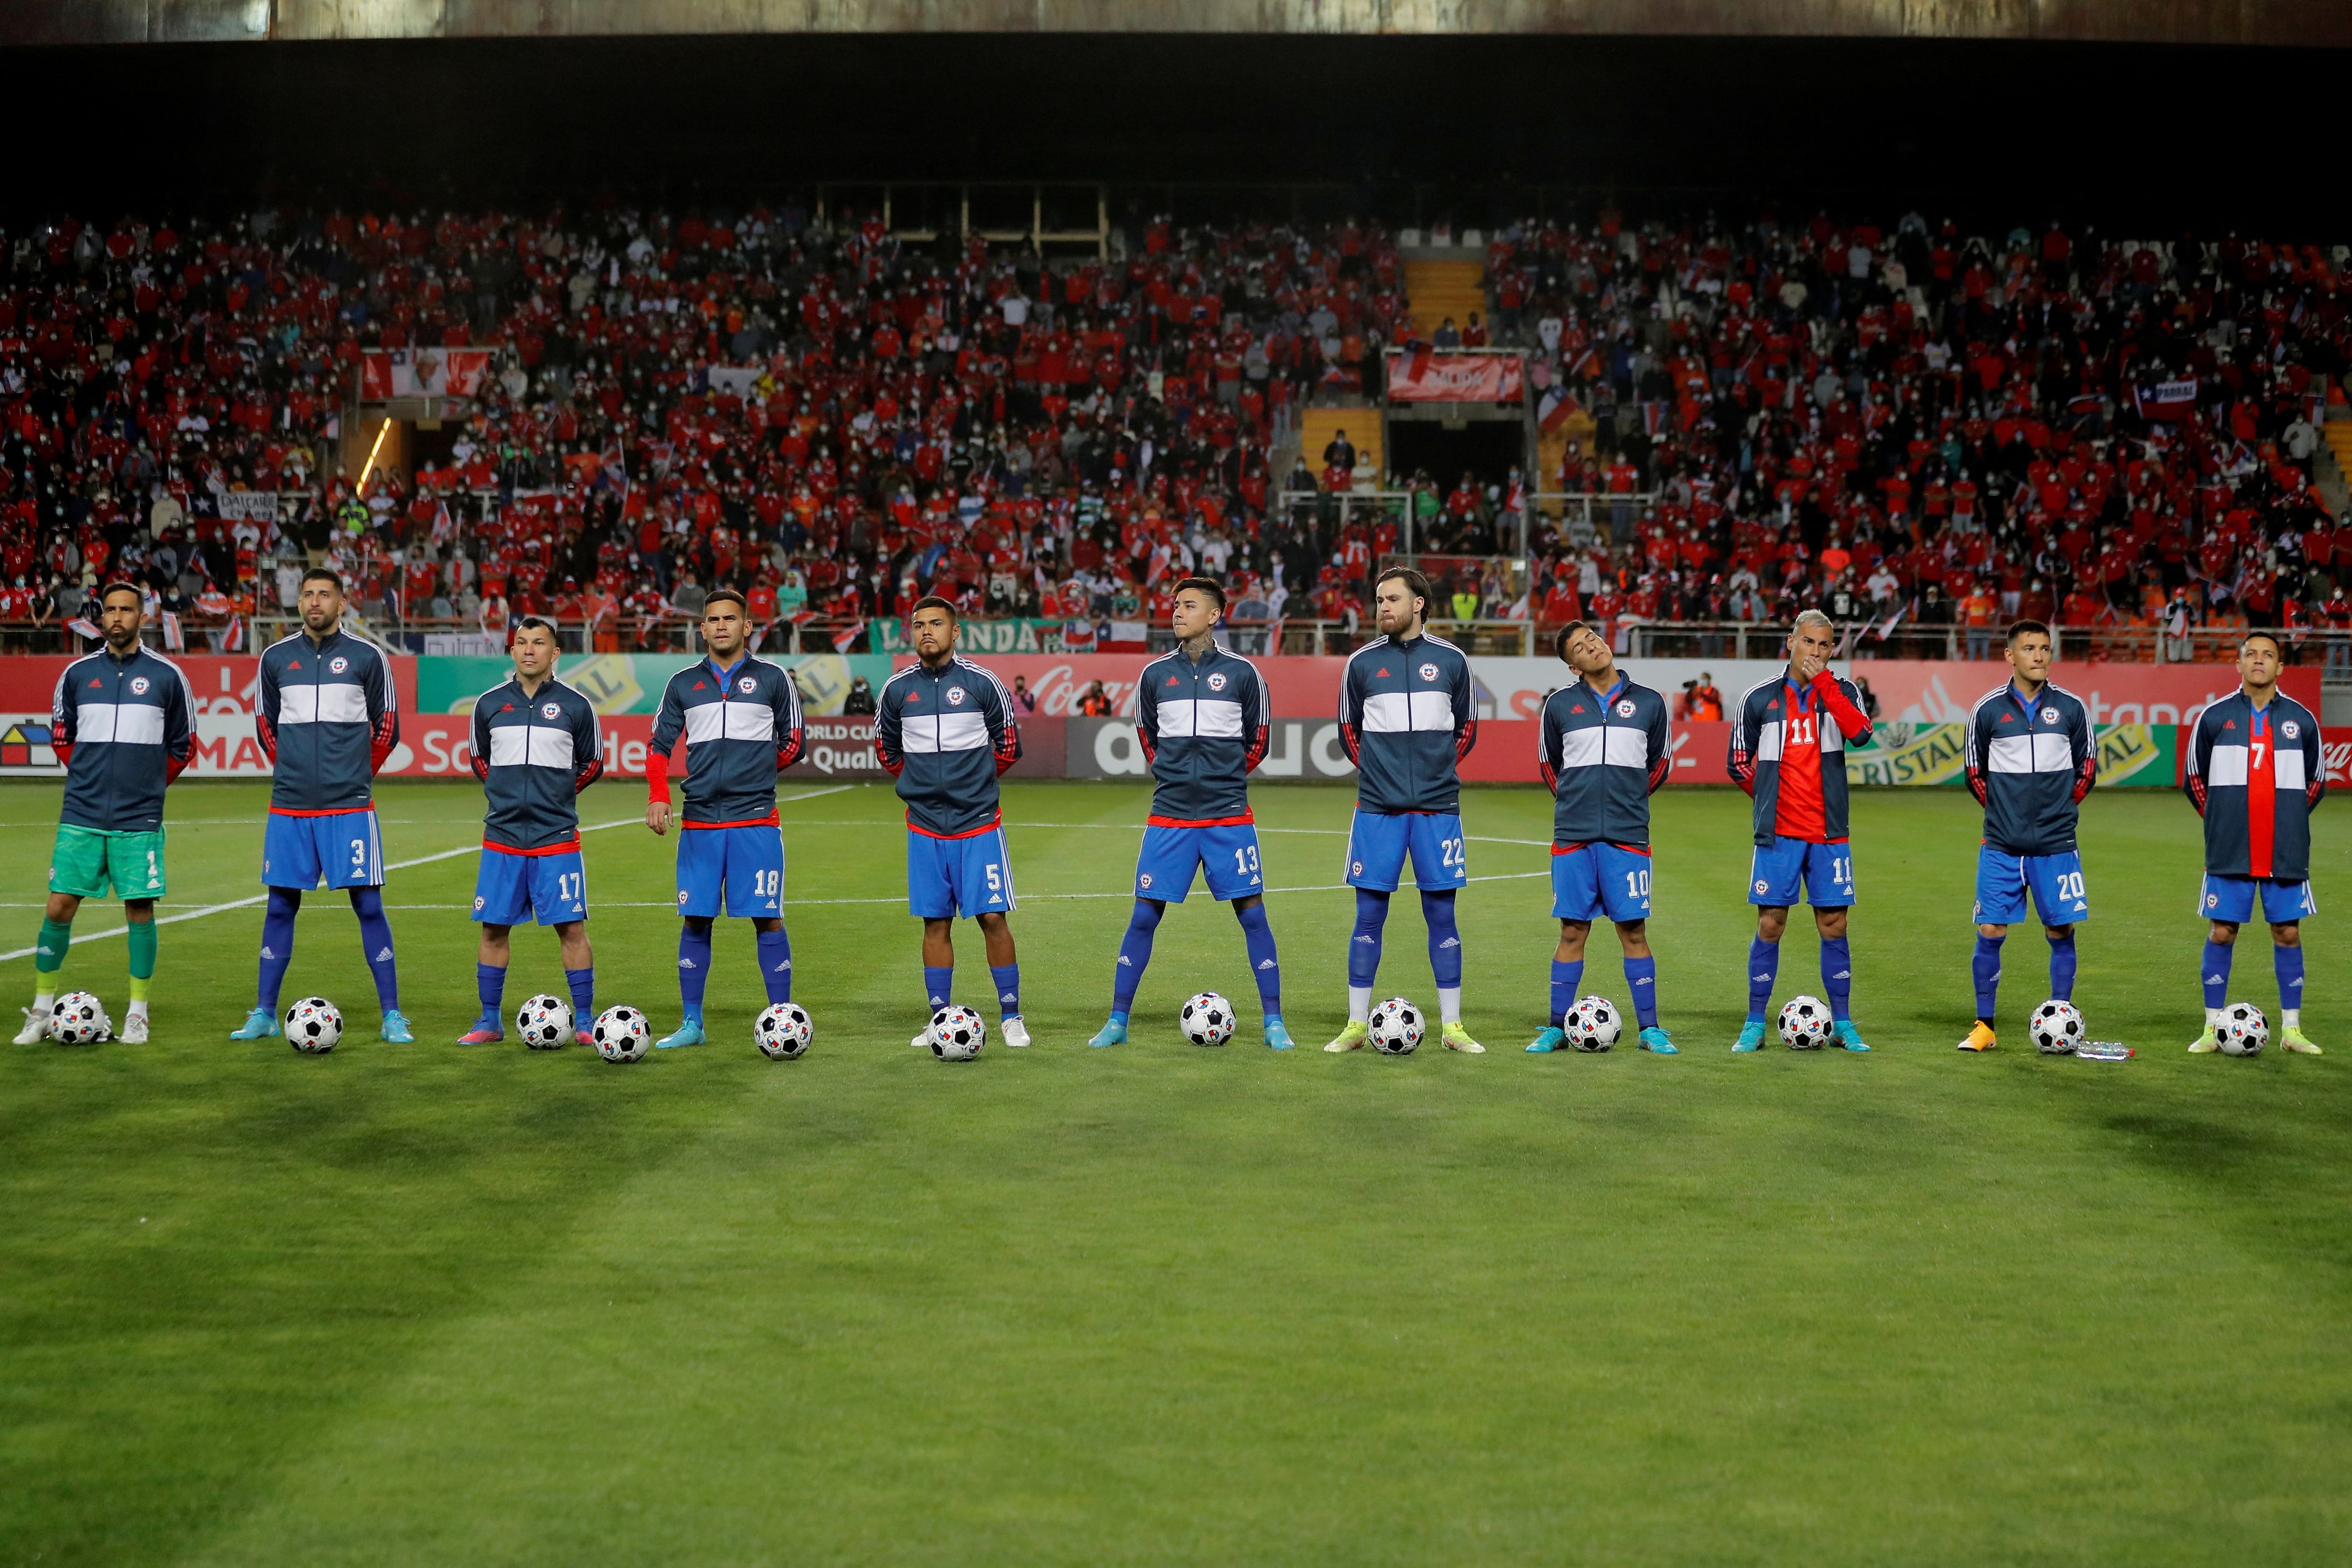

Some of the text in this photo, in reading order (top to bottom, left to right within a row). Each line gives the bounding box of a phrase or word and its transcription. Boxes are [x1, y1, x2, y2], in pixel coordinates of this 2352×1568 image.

[805, 724, 848, 740] ORLD
[1791, 718, 1815, 745] 11
[2251, 743, 2265, 769] 7
[147, 850, 159, 877] 1
[351, 839, 366, 866] 3
[1235, 845, 1259, 875] 13
[1441, 838, 1465, 867] 22
[755, 870, 779, 897] 18
[985, 864, 1001, 891] 5
[1833, 857, 1852, 883] 11
[559, 872, 580, 901] 17
[1627, 870, 1649, 898] 10
[2057, 872, 2085, 901] 20
